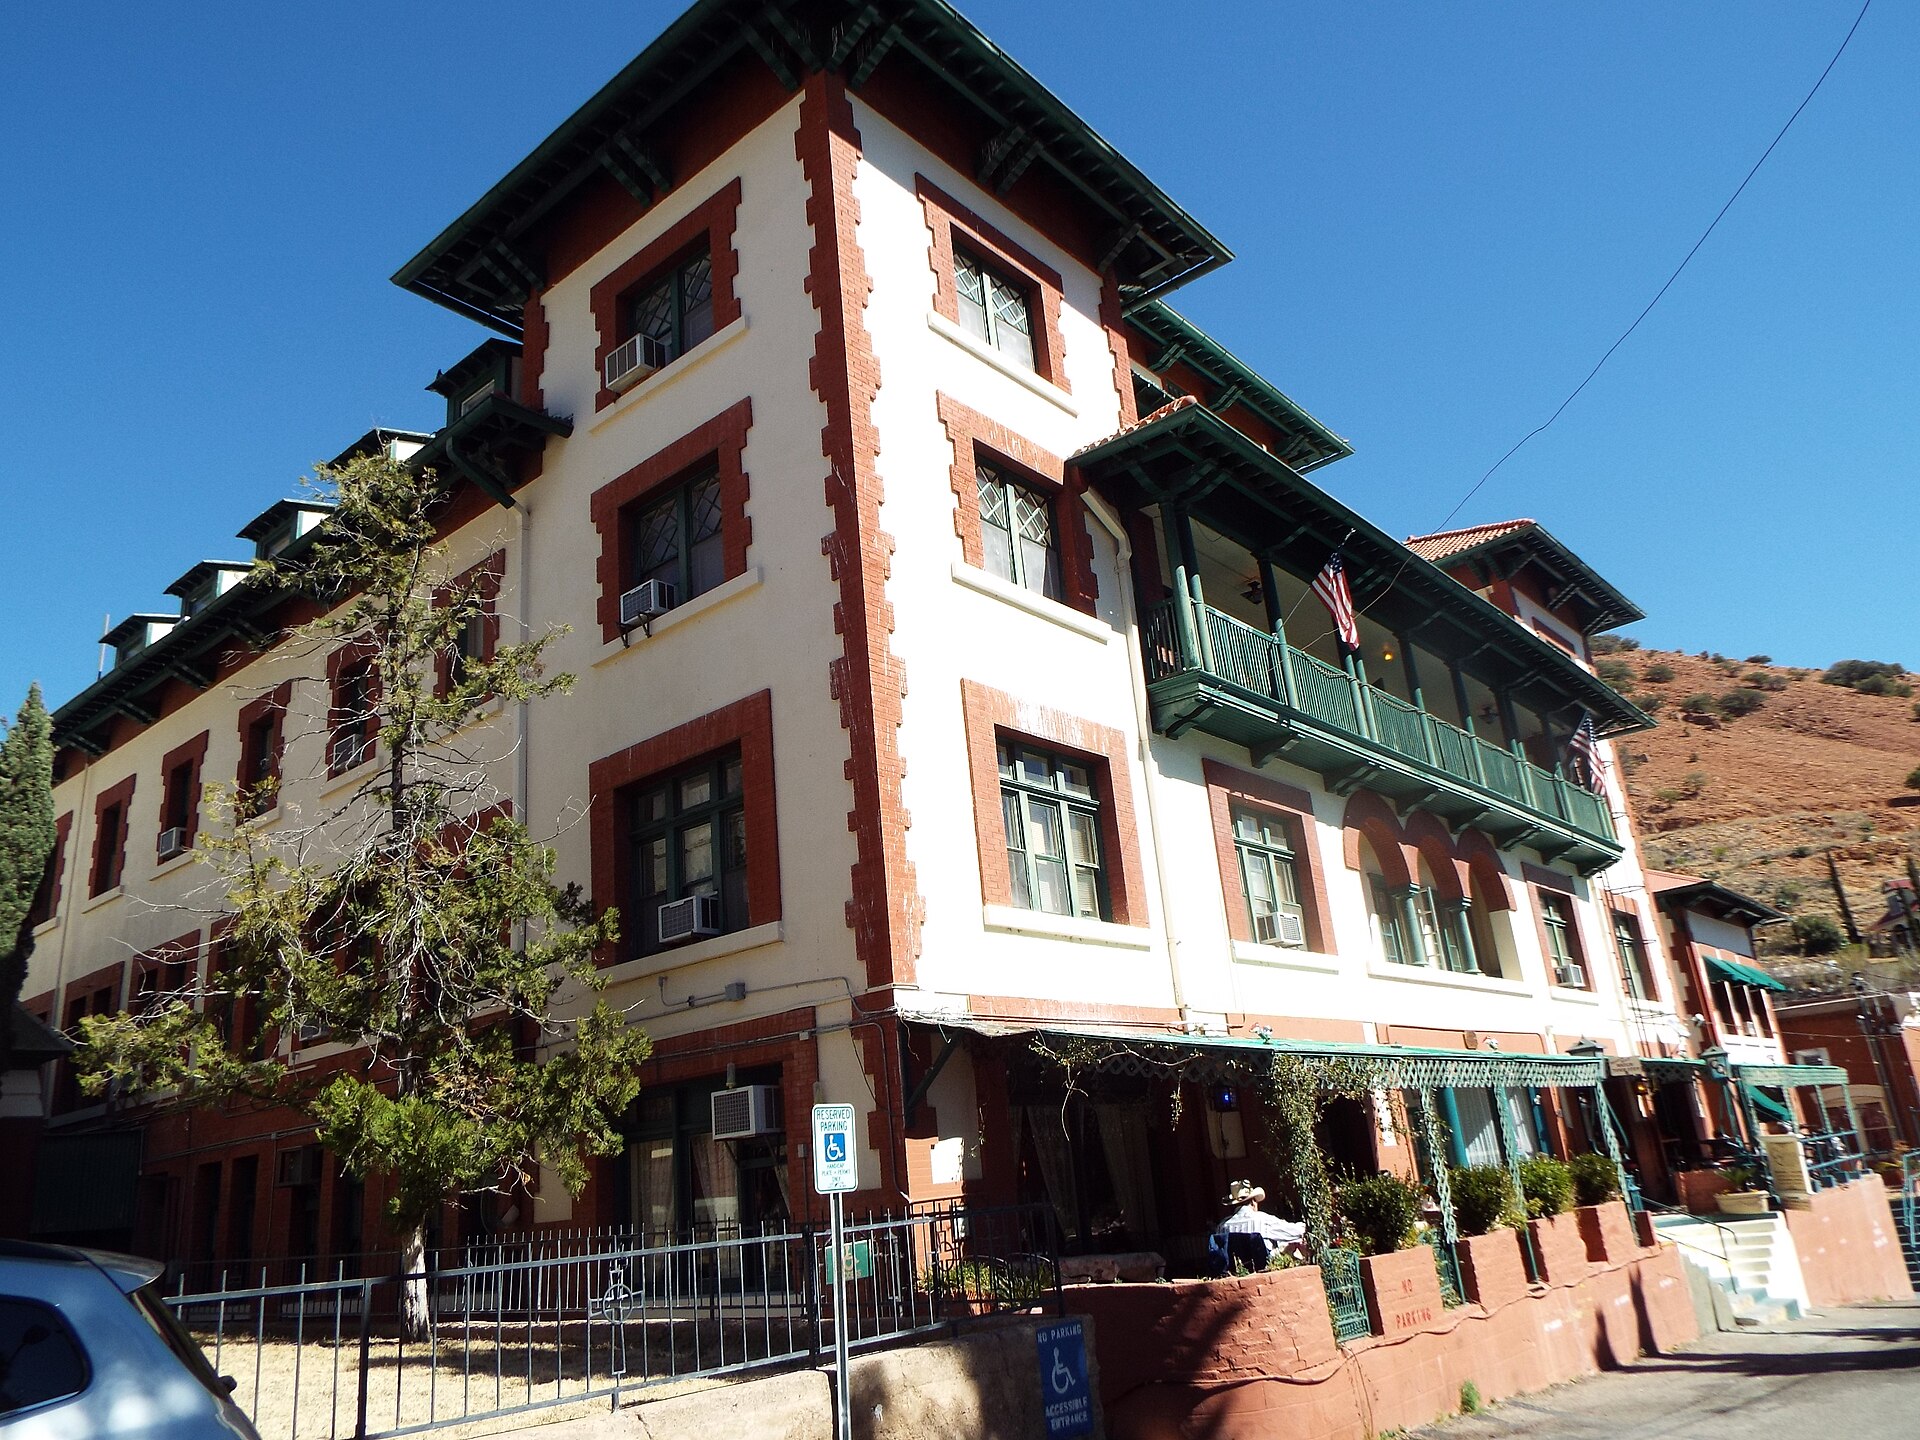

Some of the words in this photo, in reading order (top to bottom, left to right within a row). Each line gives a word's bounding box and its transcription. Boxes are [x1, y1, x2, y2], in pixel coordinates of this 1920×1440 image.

[816, 1108, 850, 1120] RESERVED
[820, 1120, 848, 1132] PARKING
[1401, 1279, 1413, 1294] NO
[1395, 1307, 1432, 1329] PARKING
[1037, 1332, 1047, 1344] NO
[1050, 1324, 1082, 1341] PARKING
[1045, 1396, 1088, 1418] ACCESSIBLE
[1050, 1412, 1088, 1431] ENTRANCE
